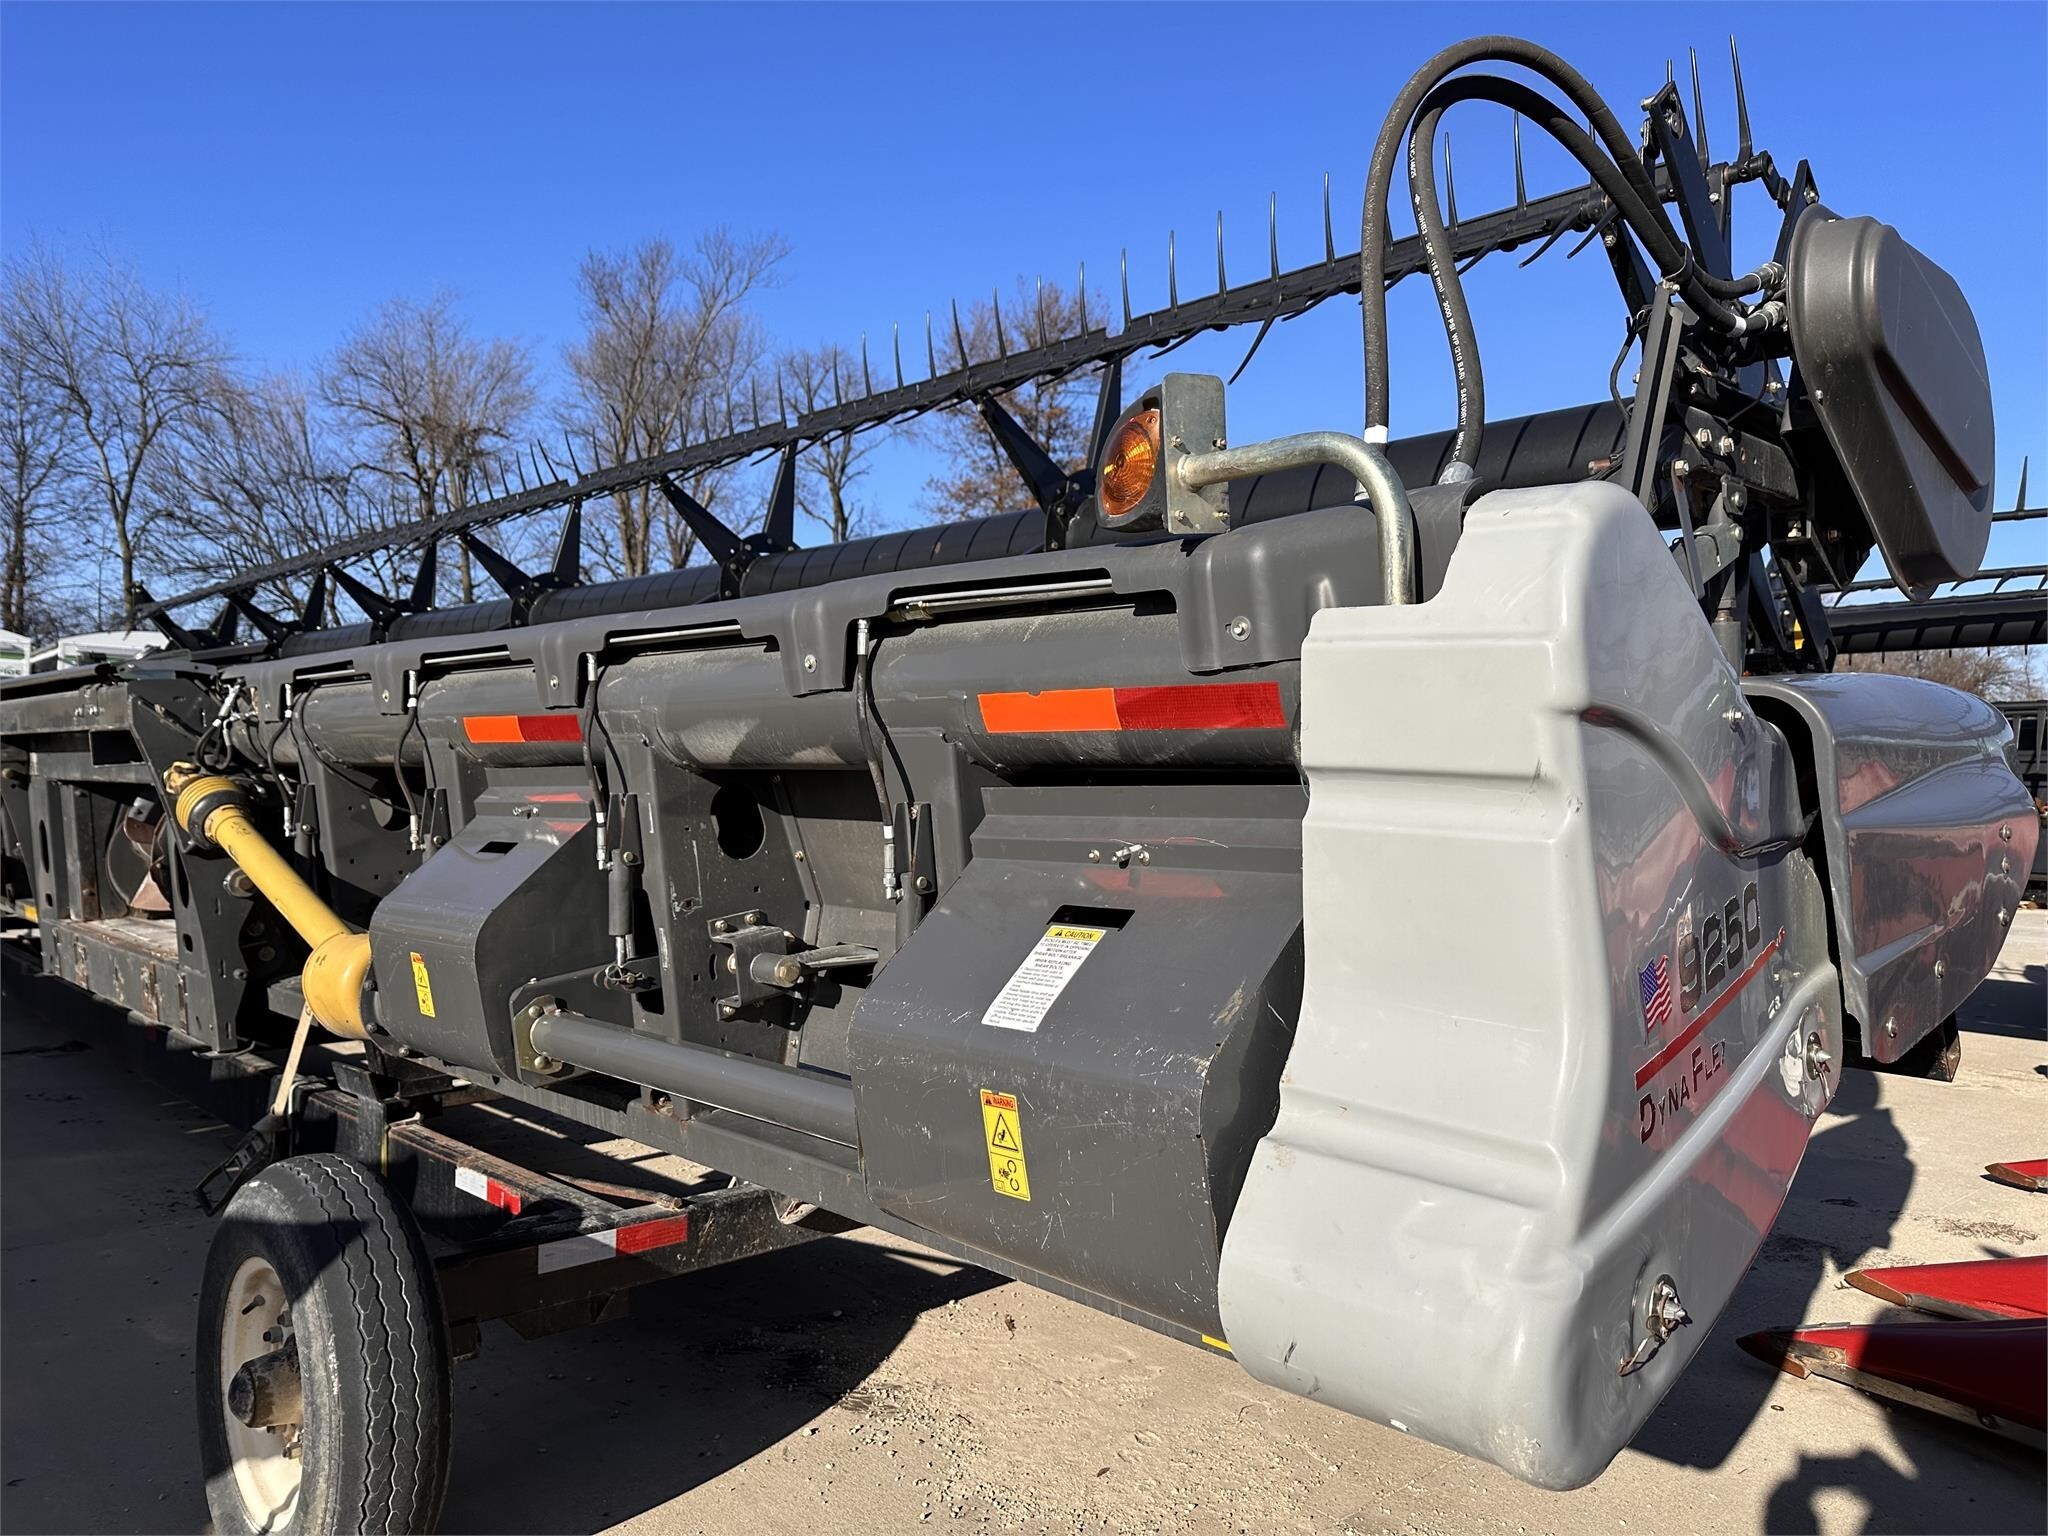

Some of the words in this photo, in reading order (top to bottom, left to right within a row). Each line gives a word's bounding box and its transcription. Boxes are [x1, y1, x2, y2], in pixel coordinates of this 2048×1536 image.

[1435, 276, 1445, 293] mm)
[1442, 300, 1452, 318] 3000
[1447, 317, 1456, 331] PSI
[1451, 332, 1460, 346] WP
[1457, 361, 1466, 380] BAR)
[1064, 930, 1095, 939] CAUTION
[1678, 881, 1761, 1013] 9250
[992, 1096, 1014, 1109] WARNING
